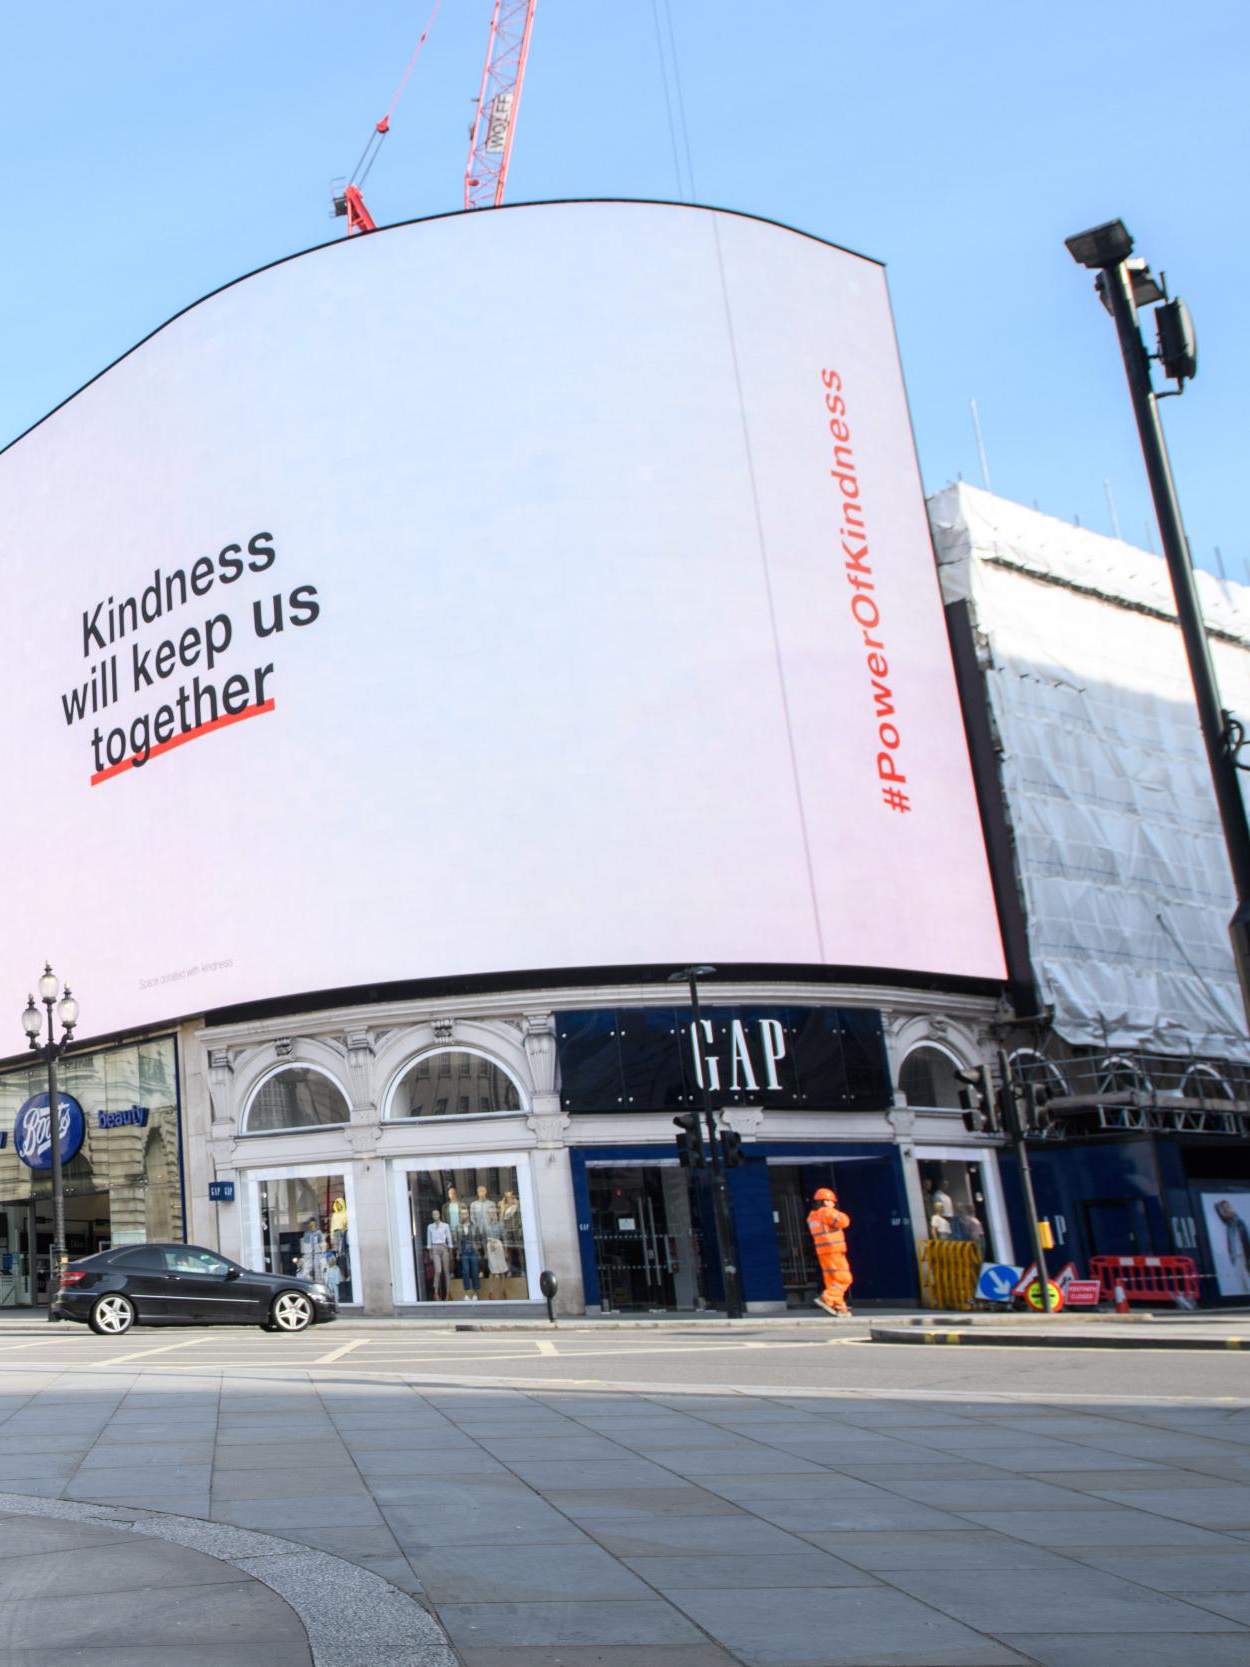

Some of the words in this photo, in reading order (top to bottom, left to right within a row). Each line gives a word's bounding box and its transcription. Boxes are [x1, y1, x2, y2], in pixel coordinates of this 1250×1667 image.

[490, 95, 510, 148] WOLFF
[82, 532, 276, 658] Kindness
[821, 367, 912, 814] #PowerOfKindness
[61, 654, 118, 726] will
[132, 613, 232, 692] keep
[253, 584, 320, 638] us
[91, 662, 275, 768] together
[690, 1018, 786, 1091] GAP
[98, 1104, 146, 1129] beauty
[1171, 1216, 1197, 1248] GAP
